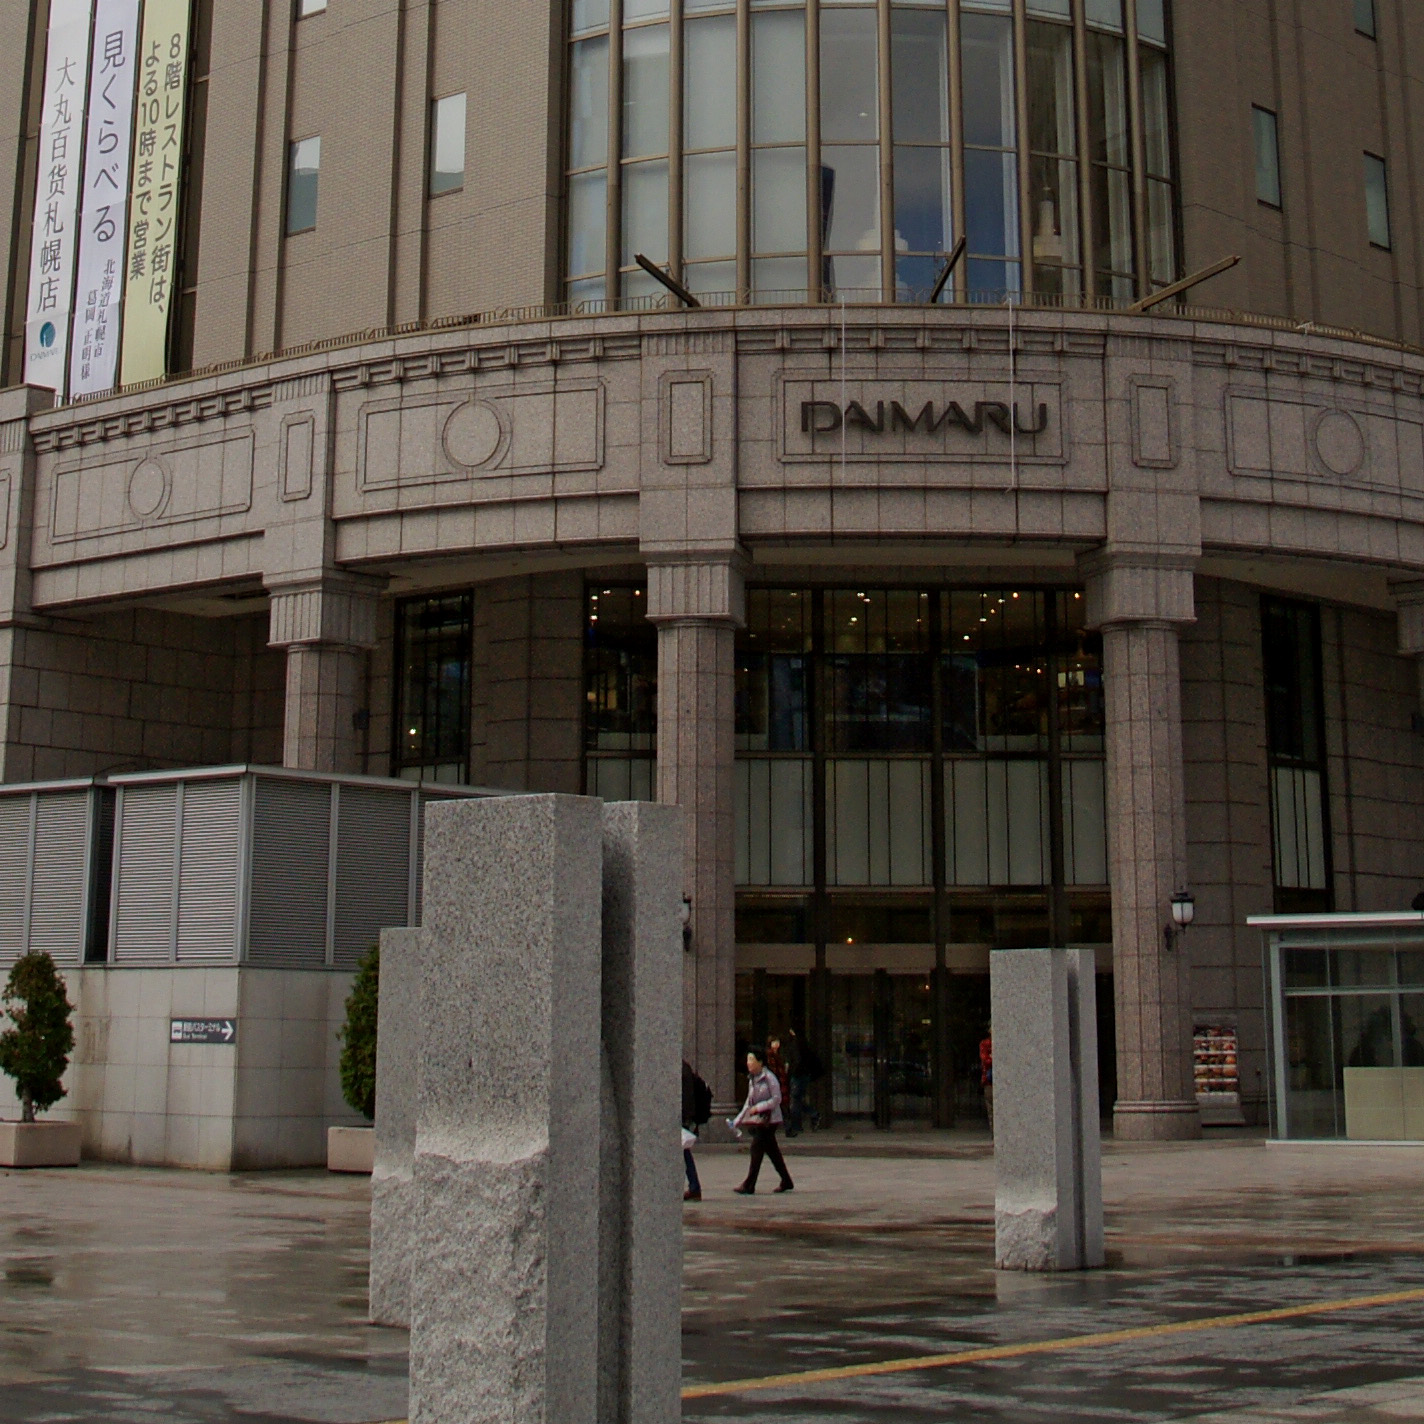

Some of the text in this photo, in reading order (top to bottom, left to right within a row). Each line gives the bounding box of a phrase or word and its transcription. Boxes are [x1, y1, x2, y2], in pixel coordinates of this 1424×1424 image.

[36, 56, 77, 314] 大丸百货札幌店
[129, 41, 162, 280] よる10時まで営業
[148, 34, 182, 313] 8階レストラン街は、
[94, 258, 116, 358] 北海道札幌市
[800, 400, 1048, 436] DAIMARU
